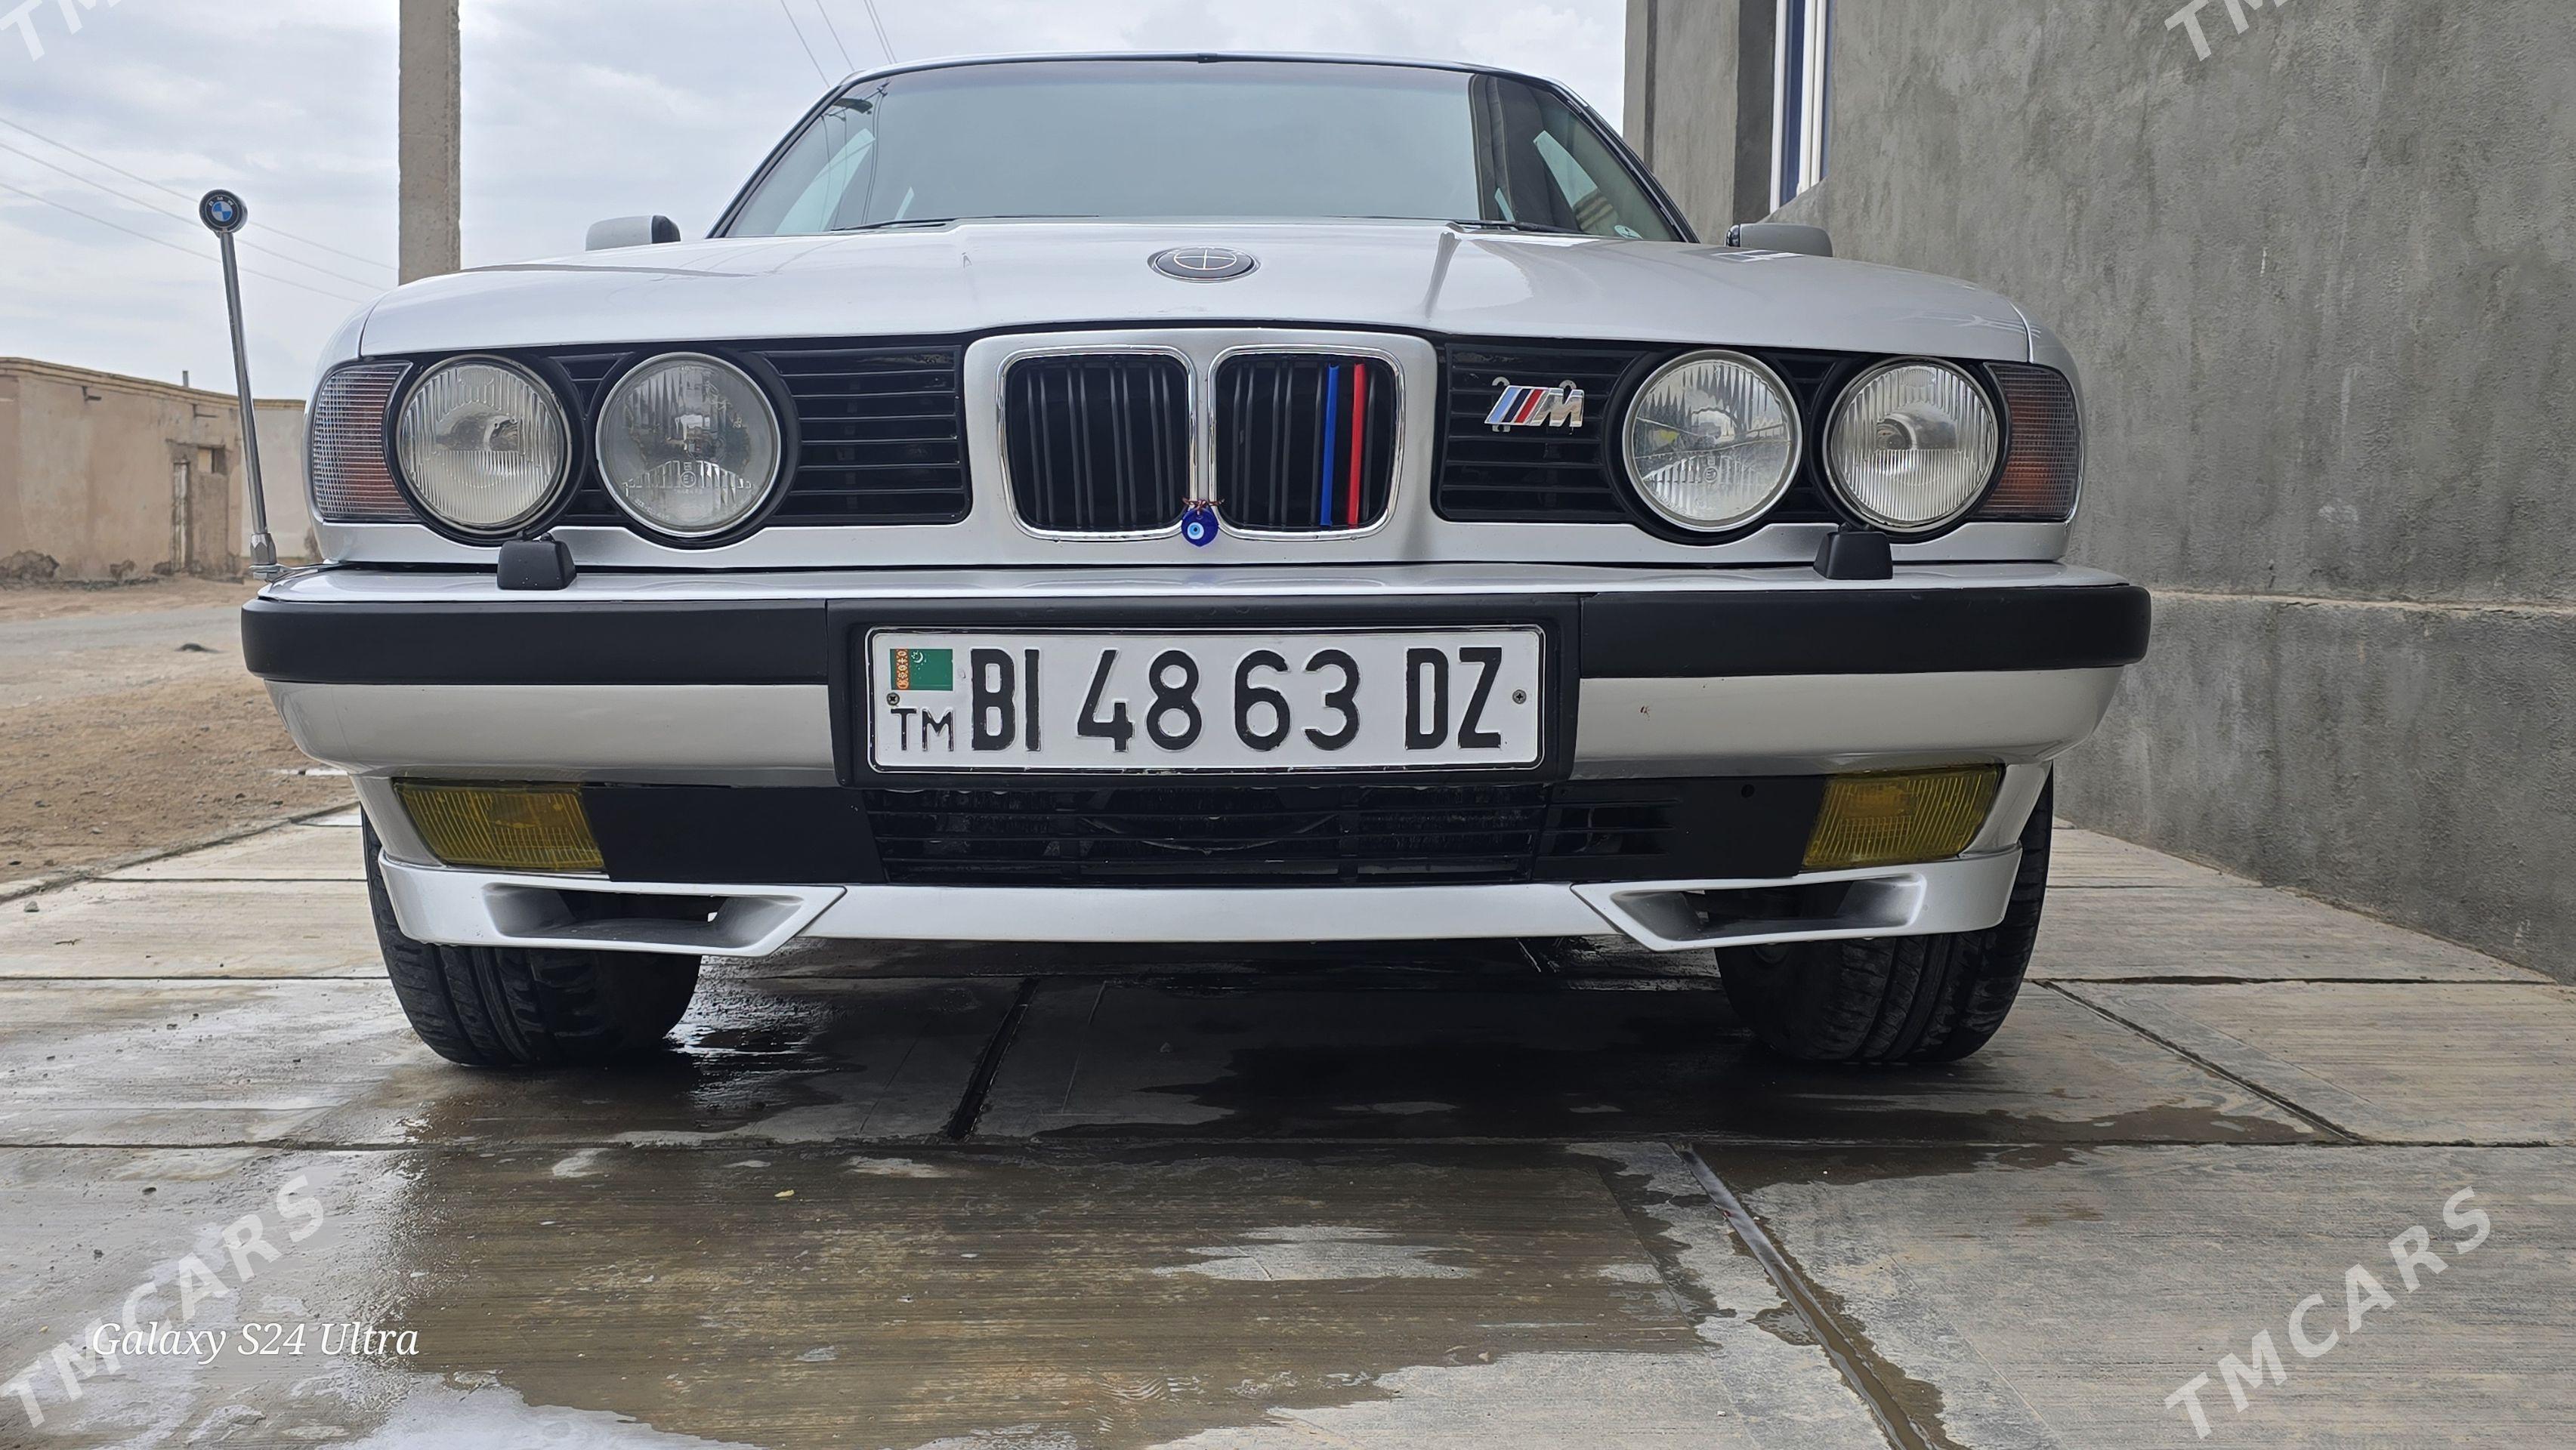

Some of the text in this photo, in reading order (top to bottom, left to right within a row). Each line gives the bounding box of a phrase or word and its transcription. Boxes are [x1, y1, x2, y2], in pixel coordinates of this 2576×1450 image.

[891, 708, 954, 751] TM
[971, 647, 1503, 752] BI 48 63 DZ
